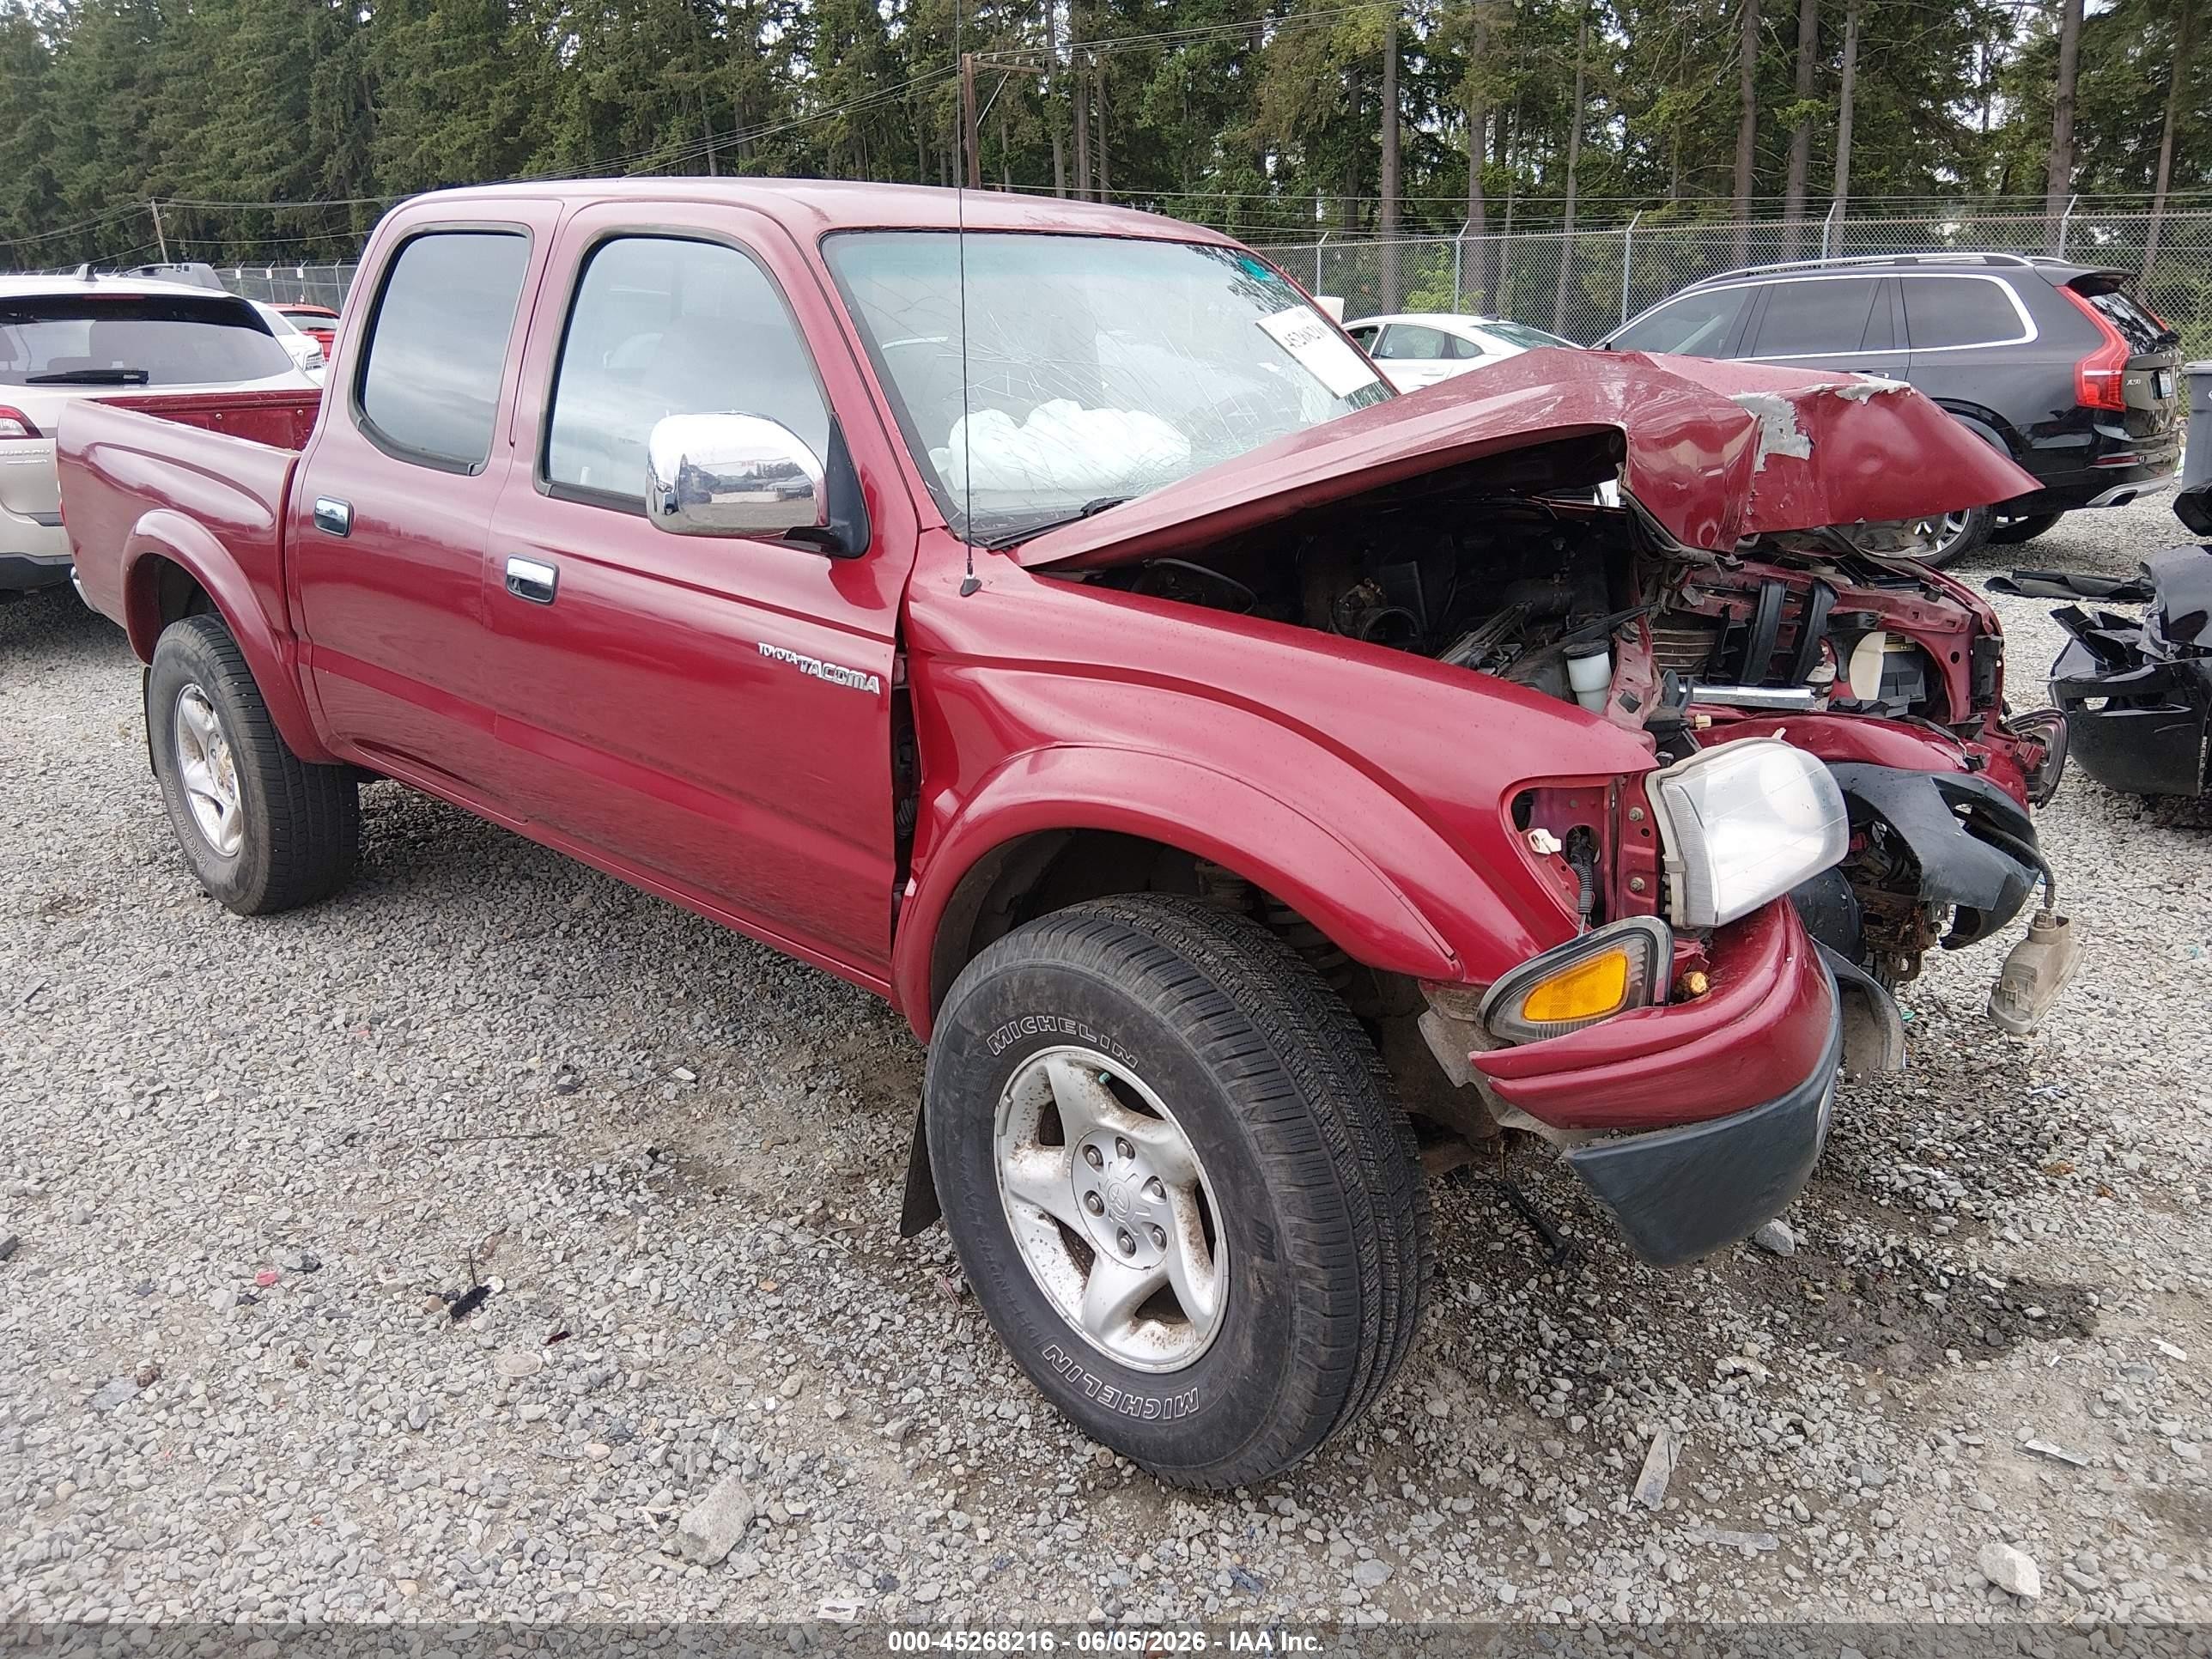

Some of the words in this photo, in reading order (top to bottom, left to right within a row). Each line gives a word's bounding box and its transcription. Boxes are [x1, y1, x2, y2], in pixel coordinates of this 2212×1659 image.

[757, 642, 798, 665] TOYOTA
[797, 655, 880, 695] TACOMA
[987, 1016, 1139, 1069] MICHELIN
[1042, 1344, 1200, 1419] MICHELIN
